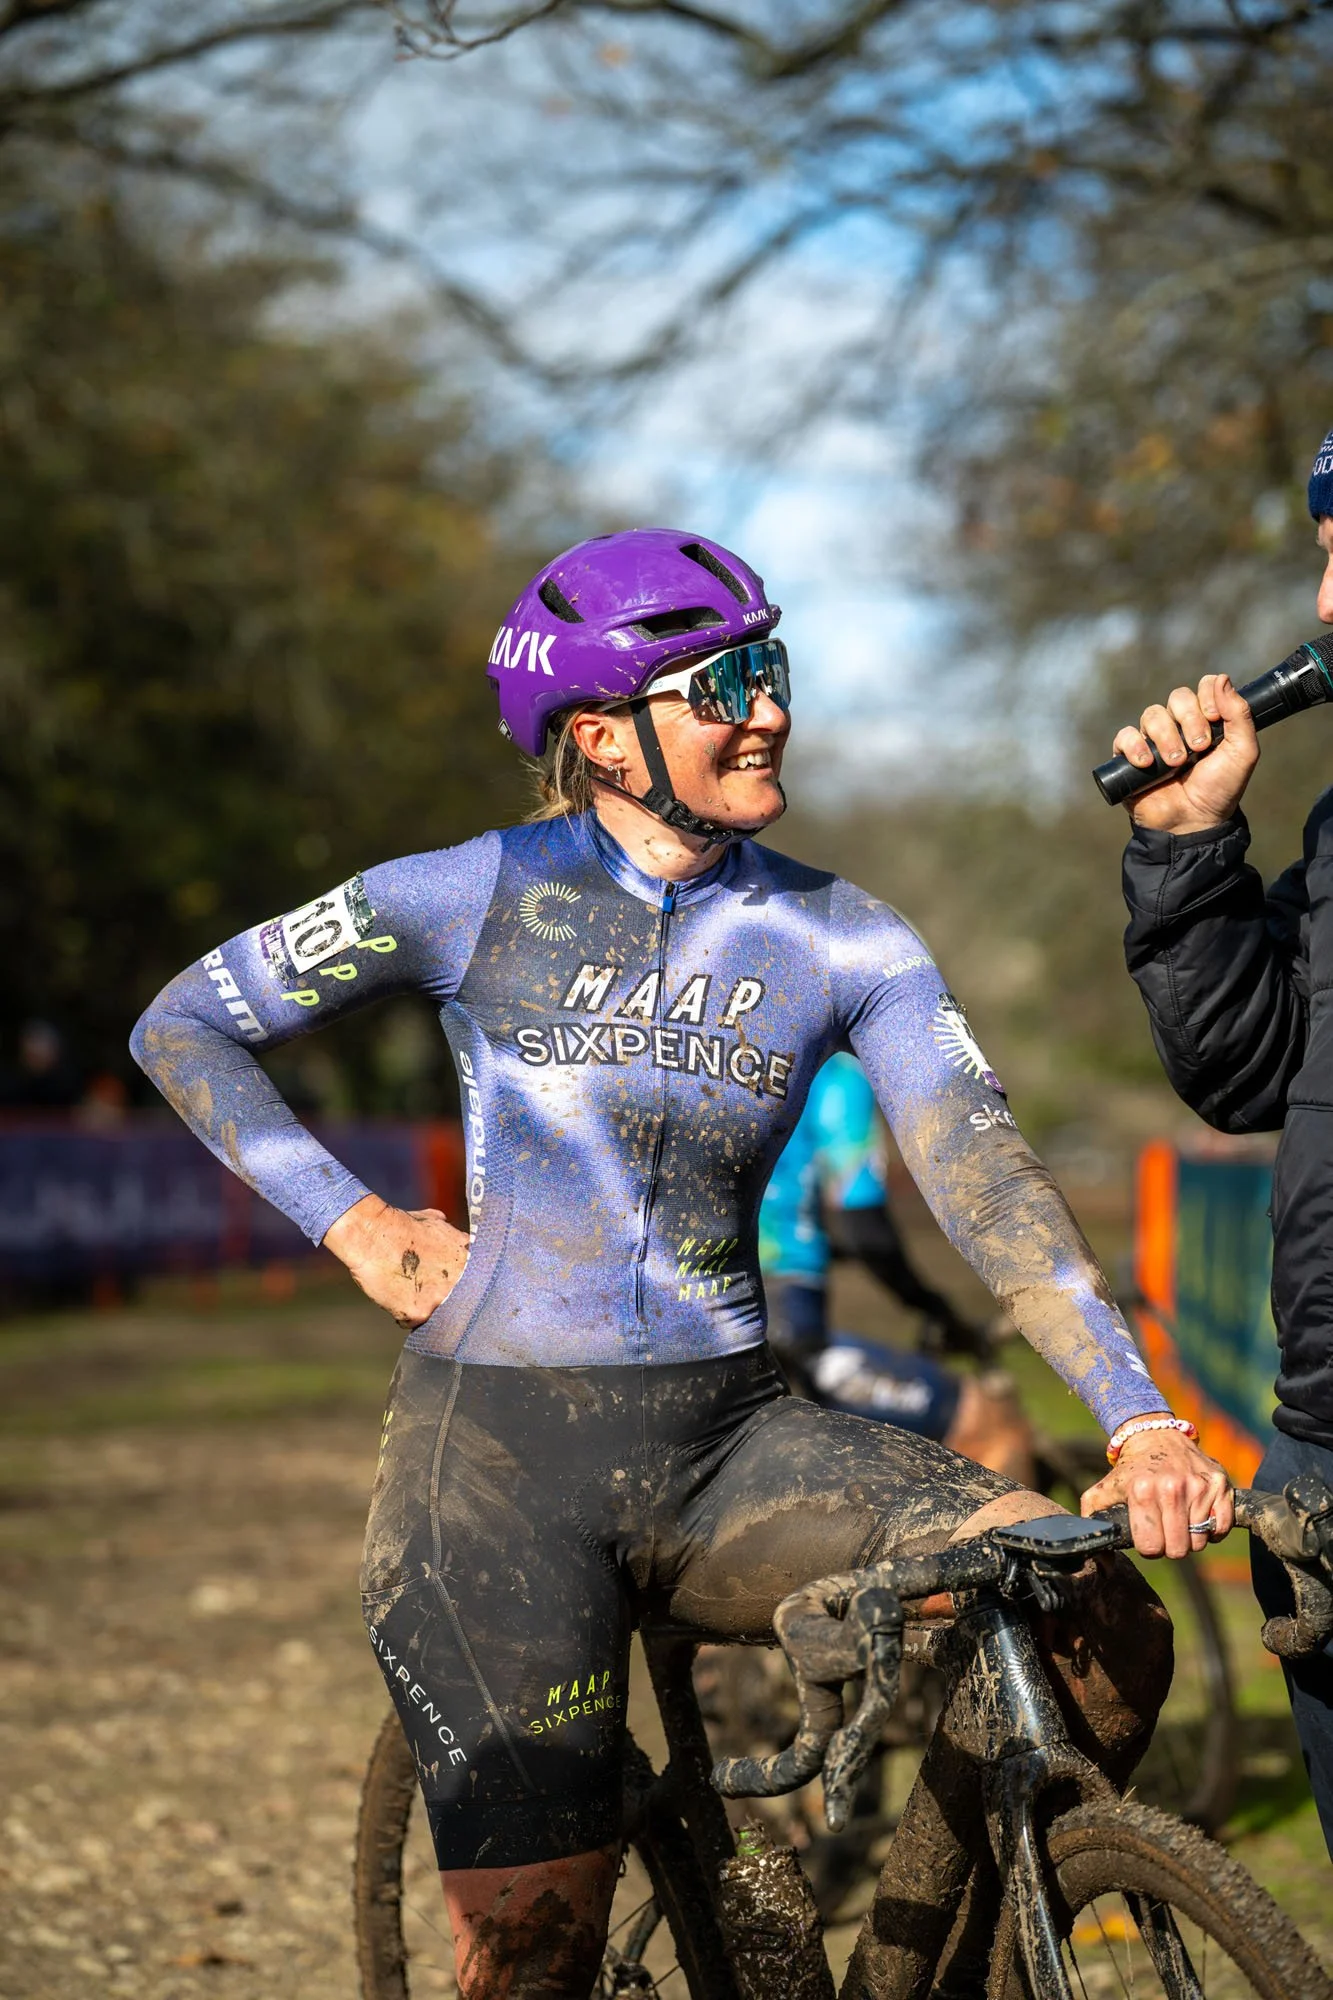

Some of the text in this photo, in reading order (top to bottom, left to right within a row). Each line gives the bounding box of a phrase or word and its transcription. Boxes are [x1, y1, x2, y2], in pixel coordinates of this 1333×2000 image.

[742, 608, 769, 626] KASK
[289, 901, 343, 958] 10
[201, 948, 269, 1042] RAM
[559, 961, 767, 1029] MAAP
[513, 1022, 796, 1099] SIXPENCE
[677, 1238, 739, 1256] MAAP
[675, 1258, 728, 1280] MAAP
[678, 1276, 732, 1301] MAAP
[369, 1625, 467, 1765] SIXPENCE
[546, 1670, 610, 1706] MAAP
[531, 1694, 622, 1735] SIXPENCE
